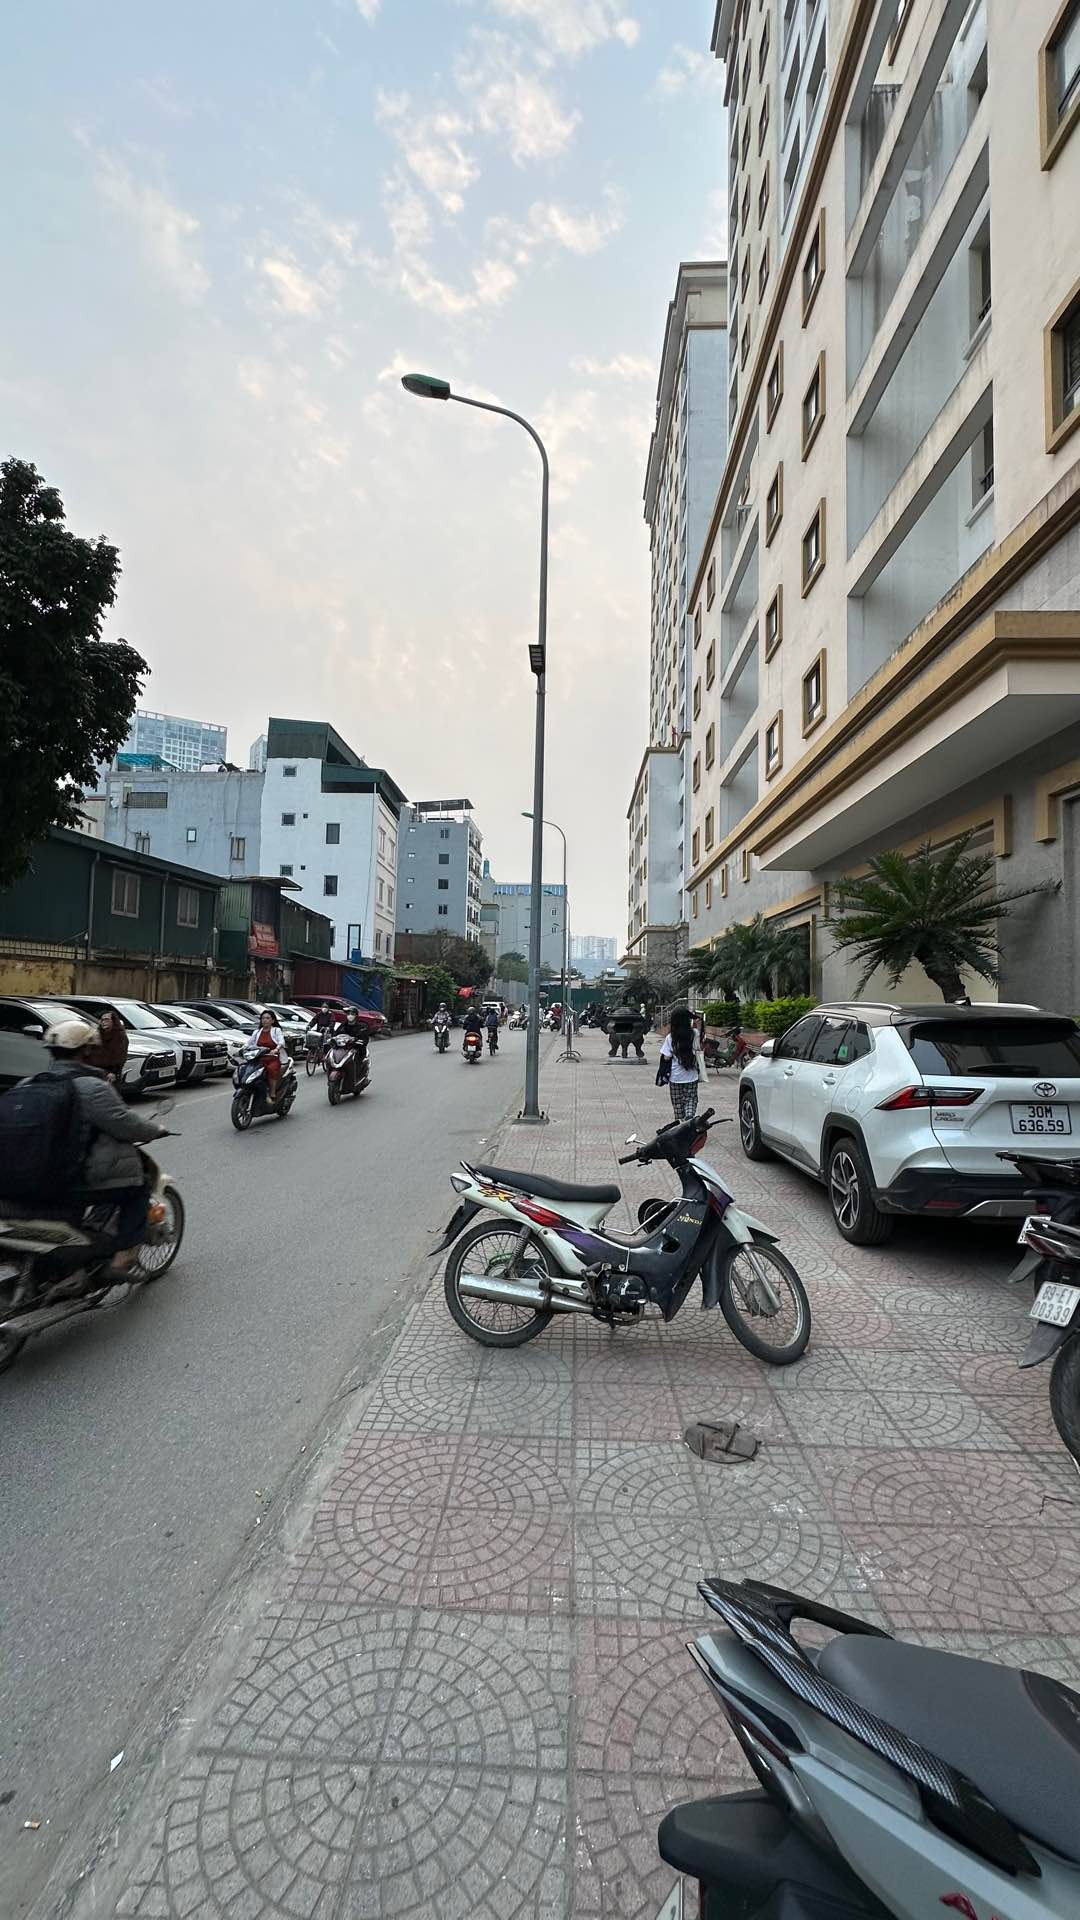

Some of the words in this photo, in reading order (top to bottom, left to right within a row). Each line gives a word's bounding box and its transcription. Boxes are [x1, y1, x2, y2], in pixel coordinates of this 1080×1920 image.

[1028, 1105, 1053, 1118] 30M
[1018, 1119, 1065, 1132] 636.59
[1042, 1285, 1074, 1305] 89-E1
